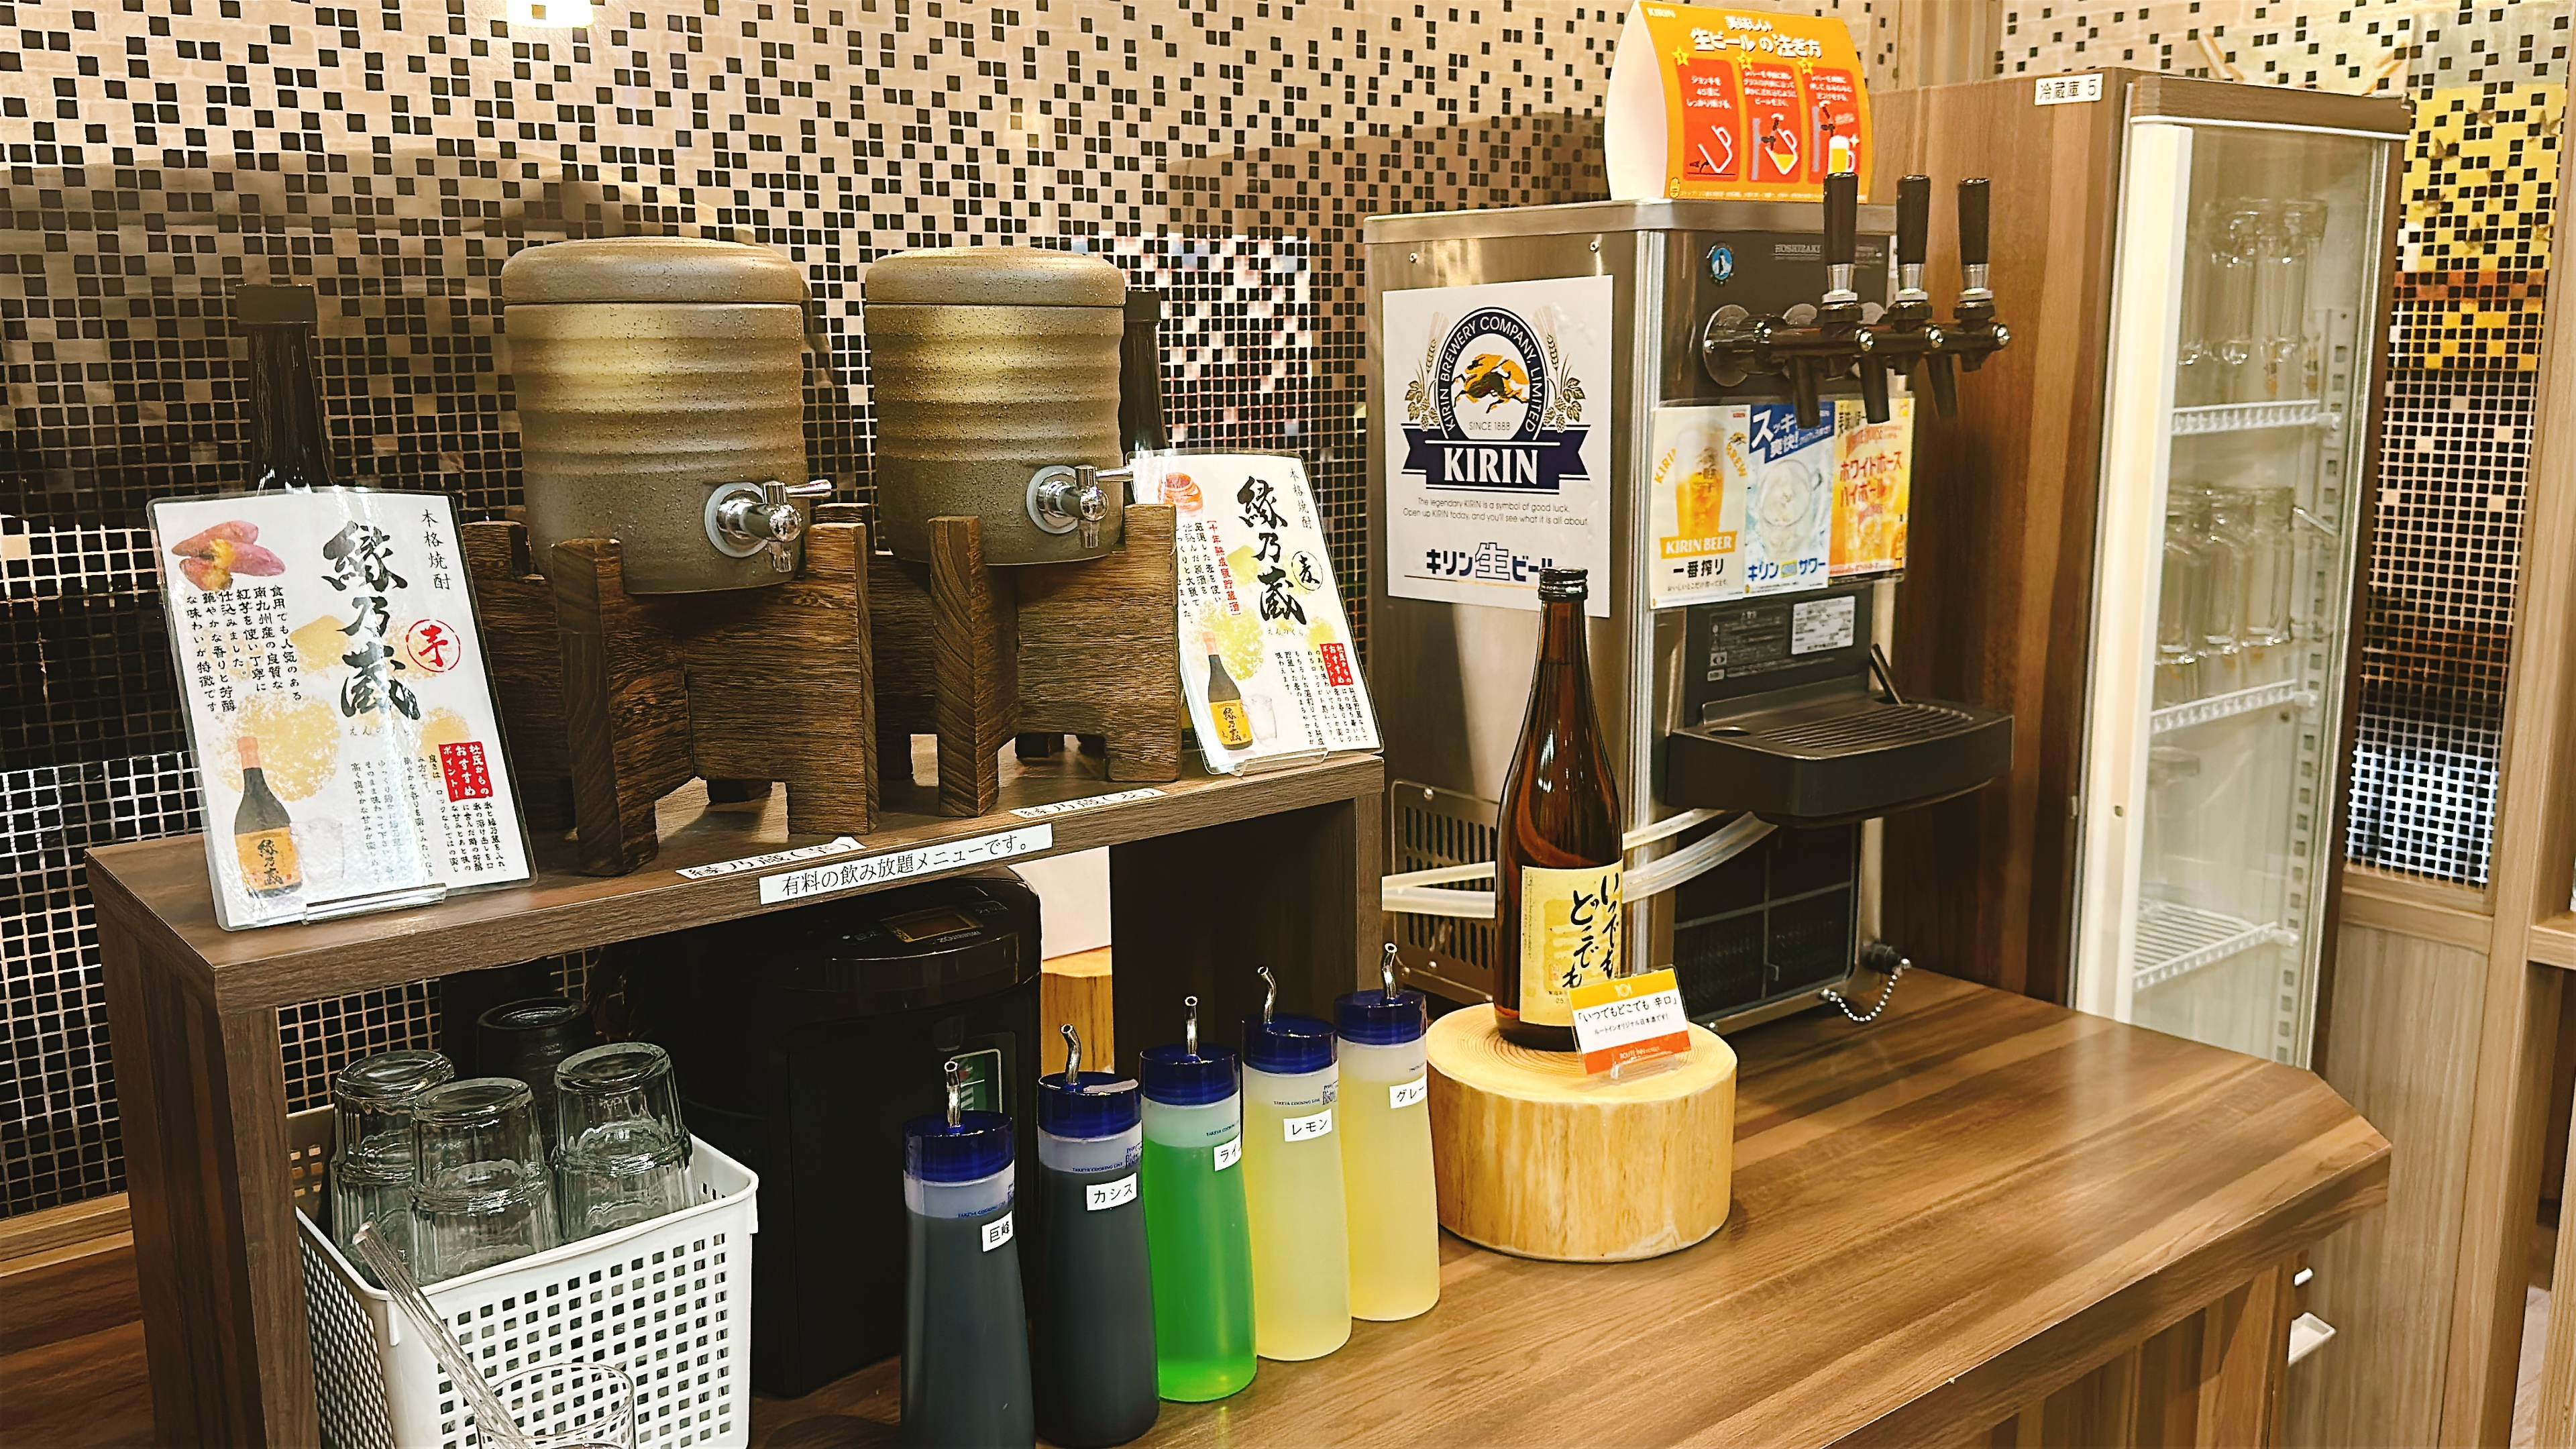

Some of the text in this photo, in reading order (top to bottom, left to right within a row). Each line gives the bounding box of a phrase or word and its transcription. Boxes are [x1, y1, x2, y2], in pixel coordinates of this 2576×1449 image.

[1646, 7, 1676, 18] KIRIN
[2039, 79, 2096, 100] 冷蔵庫 5
[1440, 316, 1543, 432] KIRIN BREWERY COMPANY, LIMITED
[1469, 421, 1511, 431] SINCE 1888
[1752, 409, 1797, 449] スッキ
[1444, 447, 1538, 486] KIRIN
[1839, 451, 1902, 482] ホワイトホース
[1289, 468, 1312, 530] 本格焼酎
[1403, 508, 1421, 517] Open
[1432, 509, 1448, 518] KIRIN
[1519, 515, 1538, 523] what
[1553, 517, 1562, 525] all
[1418, 497, 1428, 506] The
[1430, 498, 1462, 508] legendary
[1464, 500, 1481, 508] KIRIN
[1496, 502, 1520, 513] symbol
[1522, 502, 1529, 511] of
[1532, 504, 1551, 513] good
[1552, 504, 1570, 513] luck.
[422, 508, 451, 591] 本格焼酎
[1666, 535, 1733, 555] KIRIN BEER
[1673, 558, 1724, 579] 一番搾り
[1748, 561, 1779, 582] キリン
[1799, 557, 1827, 575] サワー
[219, 591, 247, 675] 仕込みました。
[236, 588, 267, 692] 紅芋を使い丁寧に
[254, 586, 284, 690] 南九州産の良質な
[321, 521, 421, 720] 縁乃蔵
[202, 592, 237, 712] 華やかな香りと芳醇
[270, 585, 302, 701] 食用でも人気のある
[419, 627, 449, 667] 芋
[455, 745, 476, 797] おすすめ
[469, 744, 490, 796] 杜氏からの
[782, 835, 1028, 896] 有料の飲み放題メニューです。
[1292, 1119, 1328, 1136] レモン
[1220, 1143, 1240, 1163] ライ
[1094, 1183, 1133, 1204] カシス
